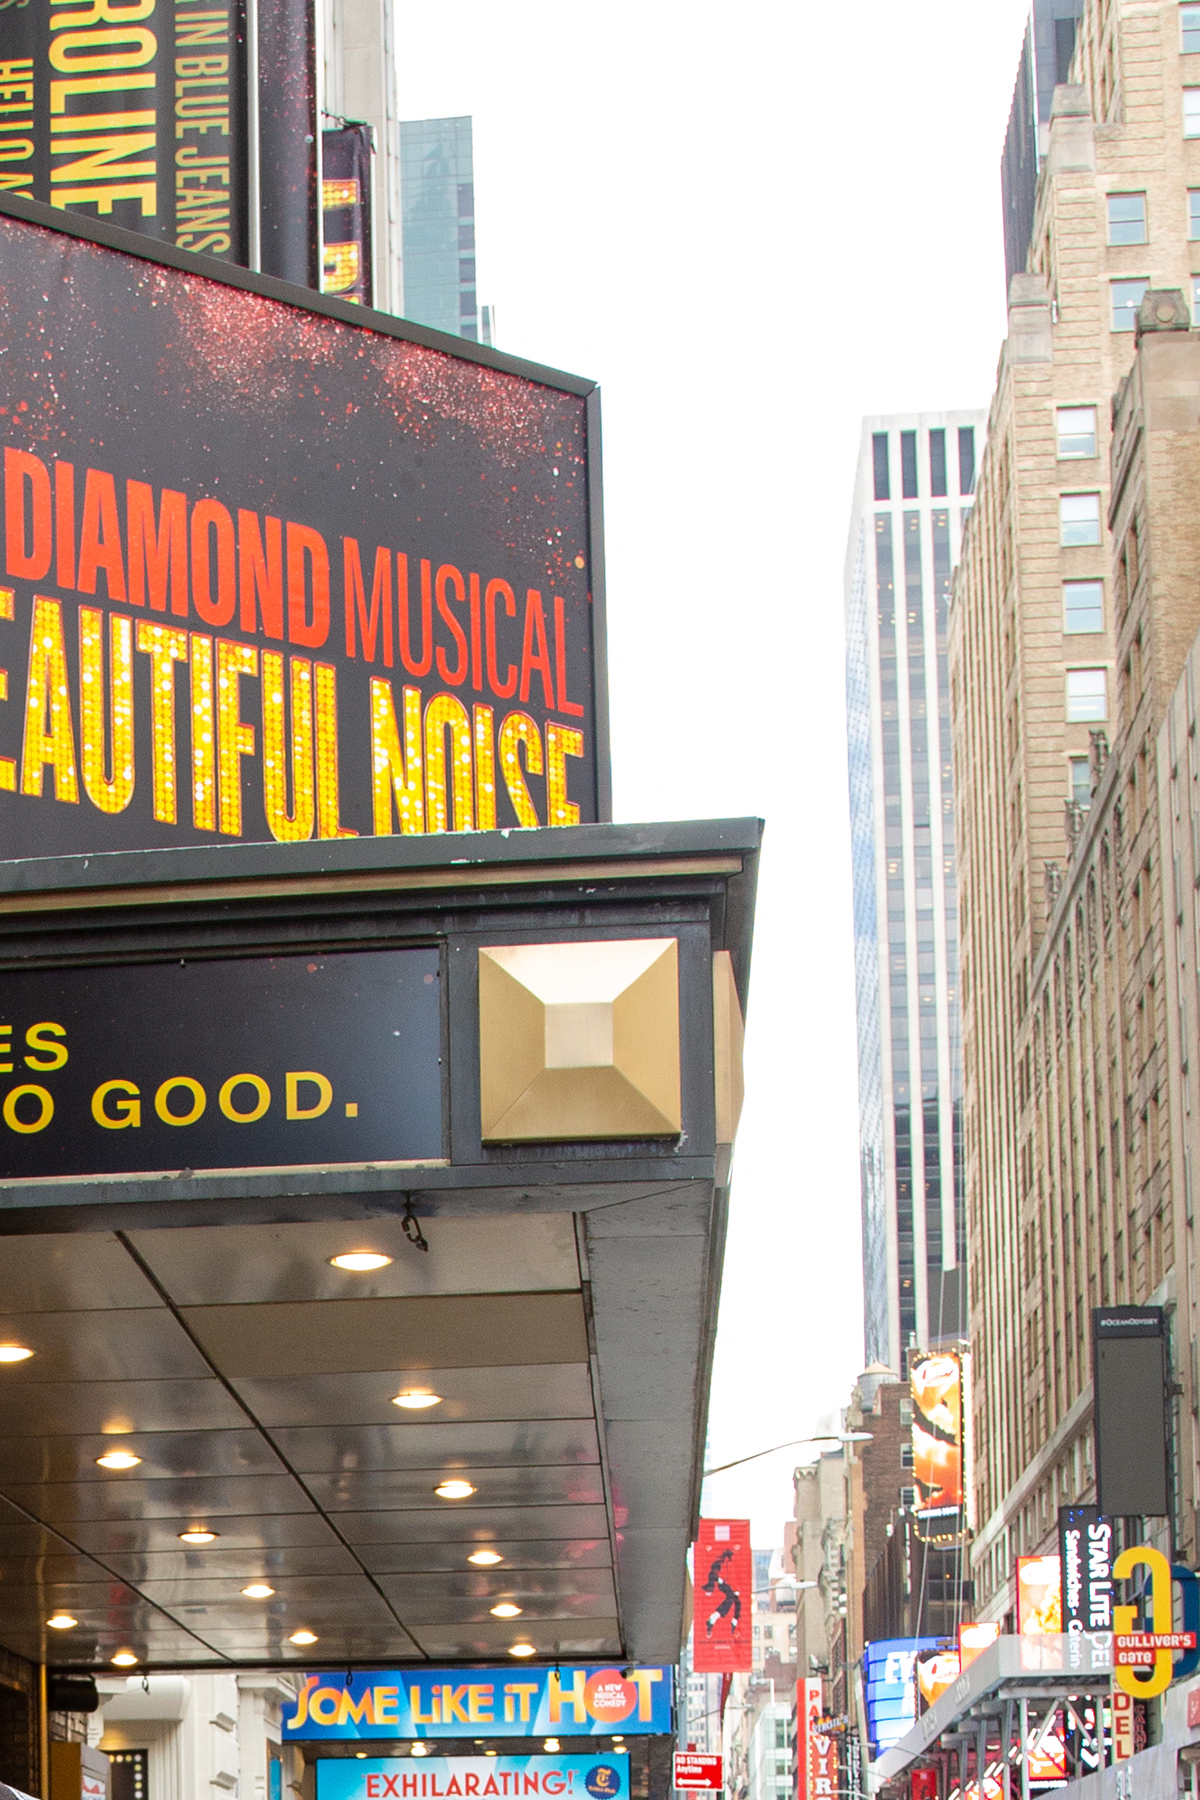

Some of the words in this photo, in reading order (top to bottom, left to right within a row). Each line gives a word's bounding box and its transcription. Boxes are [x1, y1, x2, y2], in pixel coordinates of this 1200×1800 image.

[175, 9, 230, 47] IN
[175, 54, 231, 139] BLUE
[175, 147, 231, 254] JEANS
[5, 447, 331, 649] DIAMOND
[344, 536, 584, 716] MUSICAL
[368, 676, 585, 836] NOISE
[90, 1069, 361, 1130] GOOD.
[676, 1755, 686, 1764] NO
[687, 1756, 717, 1766] STANDING
[676, 1765, 702, 1774] Anytime
